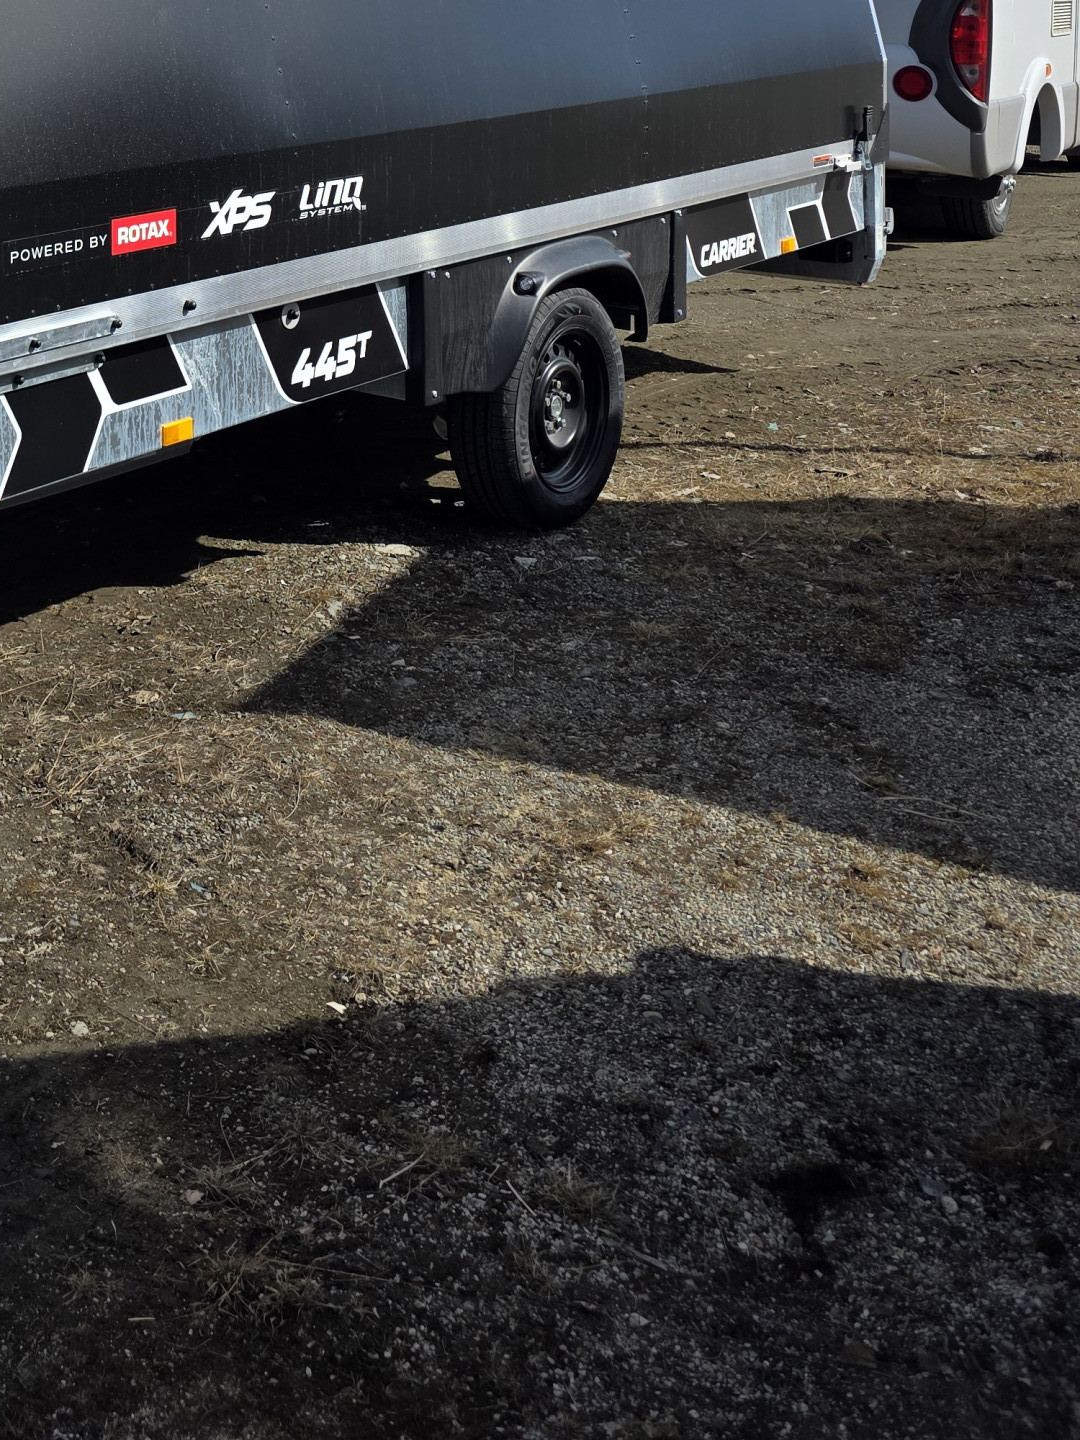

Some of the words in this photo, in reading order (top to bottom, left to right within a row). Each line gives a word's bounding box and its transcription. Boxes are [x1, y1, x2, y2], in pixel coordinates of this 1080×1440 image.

[200, 188, 277, 239] XPS
[299, 203, 354, 220] SYSTEM
[9, 238, 84, 264] POWERED
[89, 233, 108, 249] BY
[117, 218, 171, 246] ROTAX
[700, 231, 757, 268] CARRIER
